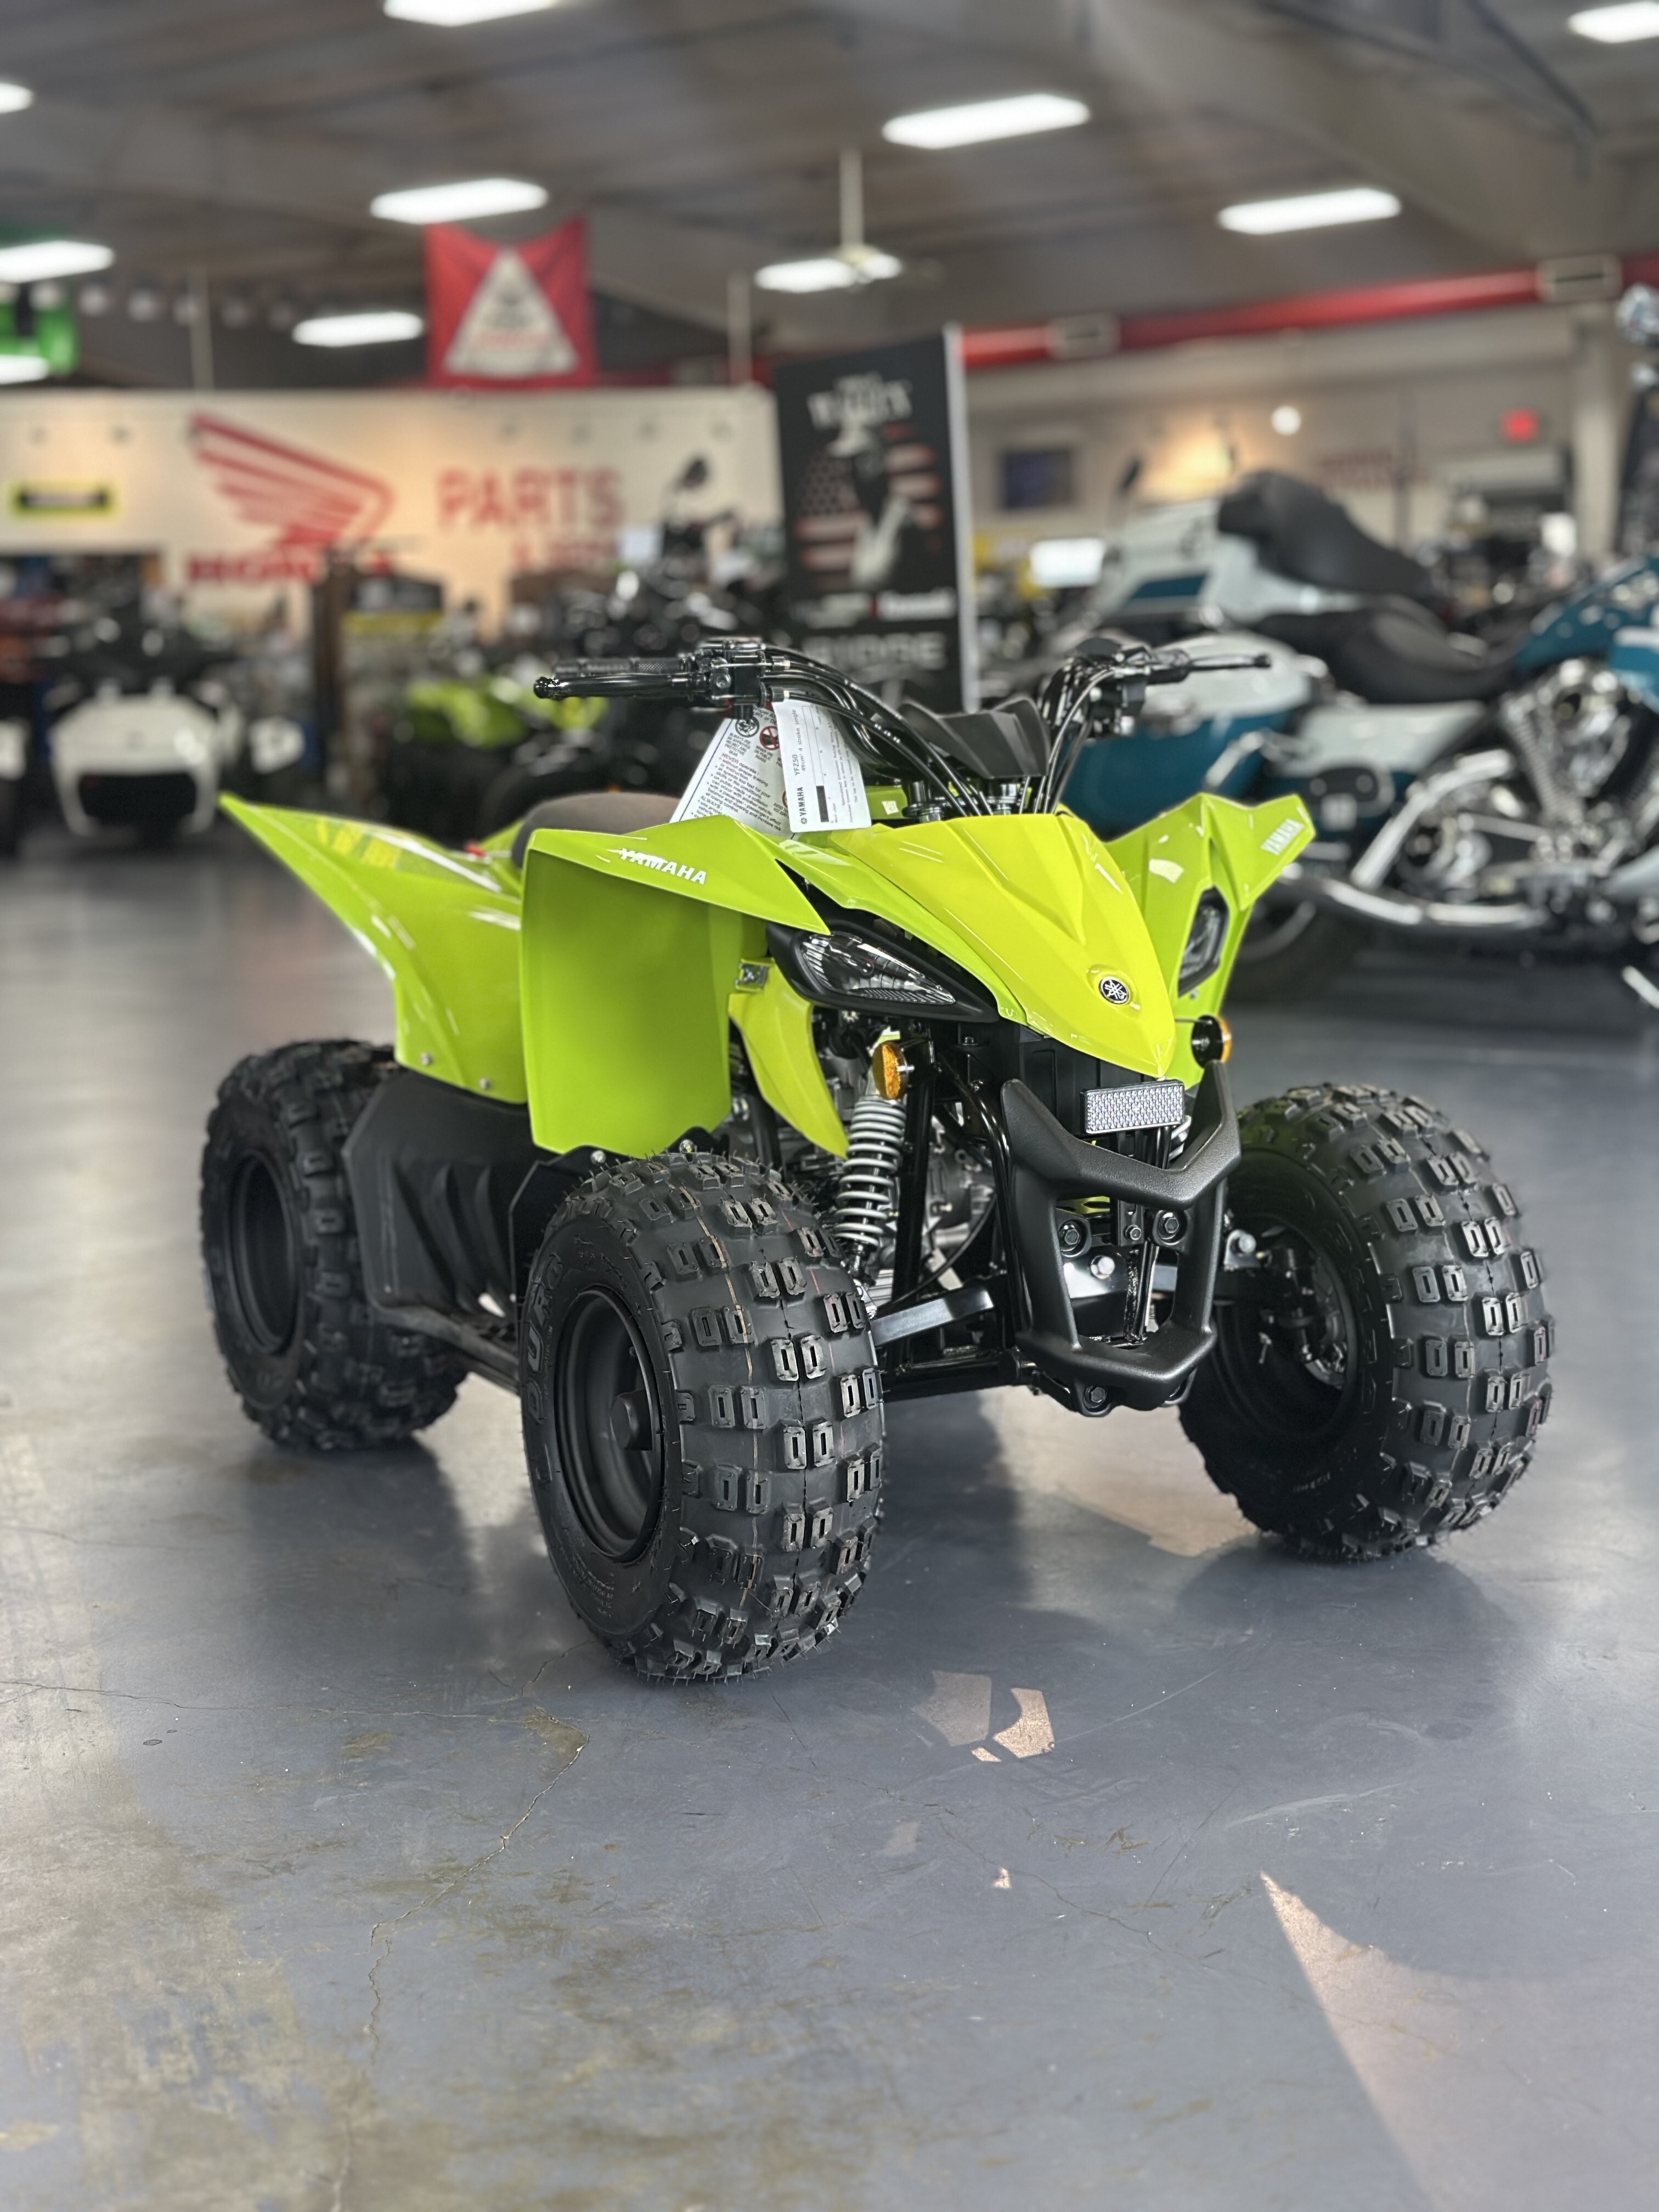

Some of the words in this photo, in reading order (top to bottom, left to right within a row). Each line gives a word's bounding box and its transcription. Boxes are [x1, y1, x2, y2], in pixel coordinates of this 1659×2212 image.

[437, 466, 624, 527] PARTS
[721, 753, 738, 764] NEVER
[722, 759, 738, 769] without
[737, 768, 753, 778] proper
[752, 775, 769, 787] training
[716, 771, 727, 779] skills
[723, 770, 738, 781] speeds
[707, 788, 724, 799] balance
[732, 802, 749, 814] steering
[757, 815, 774, 827] increase
[710, 794, 723, 804] losing
[719, 778, 733, 788] public
[733, 786, 746, 795] roads
[751, 795, 768, 808] collision
[720, 784, 732, 793] occur
[742, 796, 758, 807] another
[797, 787, 806, 816] YAMAHA
[722, 791, 744, 805] passenger
[746, 804, 769, 819] passengers
[769, 817, 781, 825] affect
[1261, 818, 1305, 856] YAMAHA
[619, 848, 707, 885] YAMAHA
[526, 1252, 563, 1425] DURO
